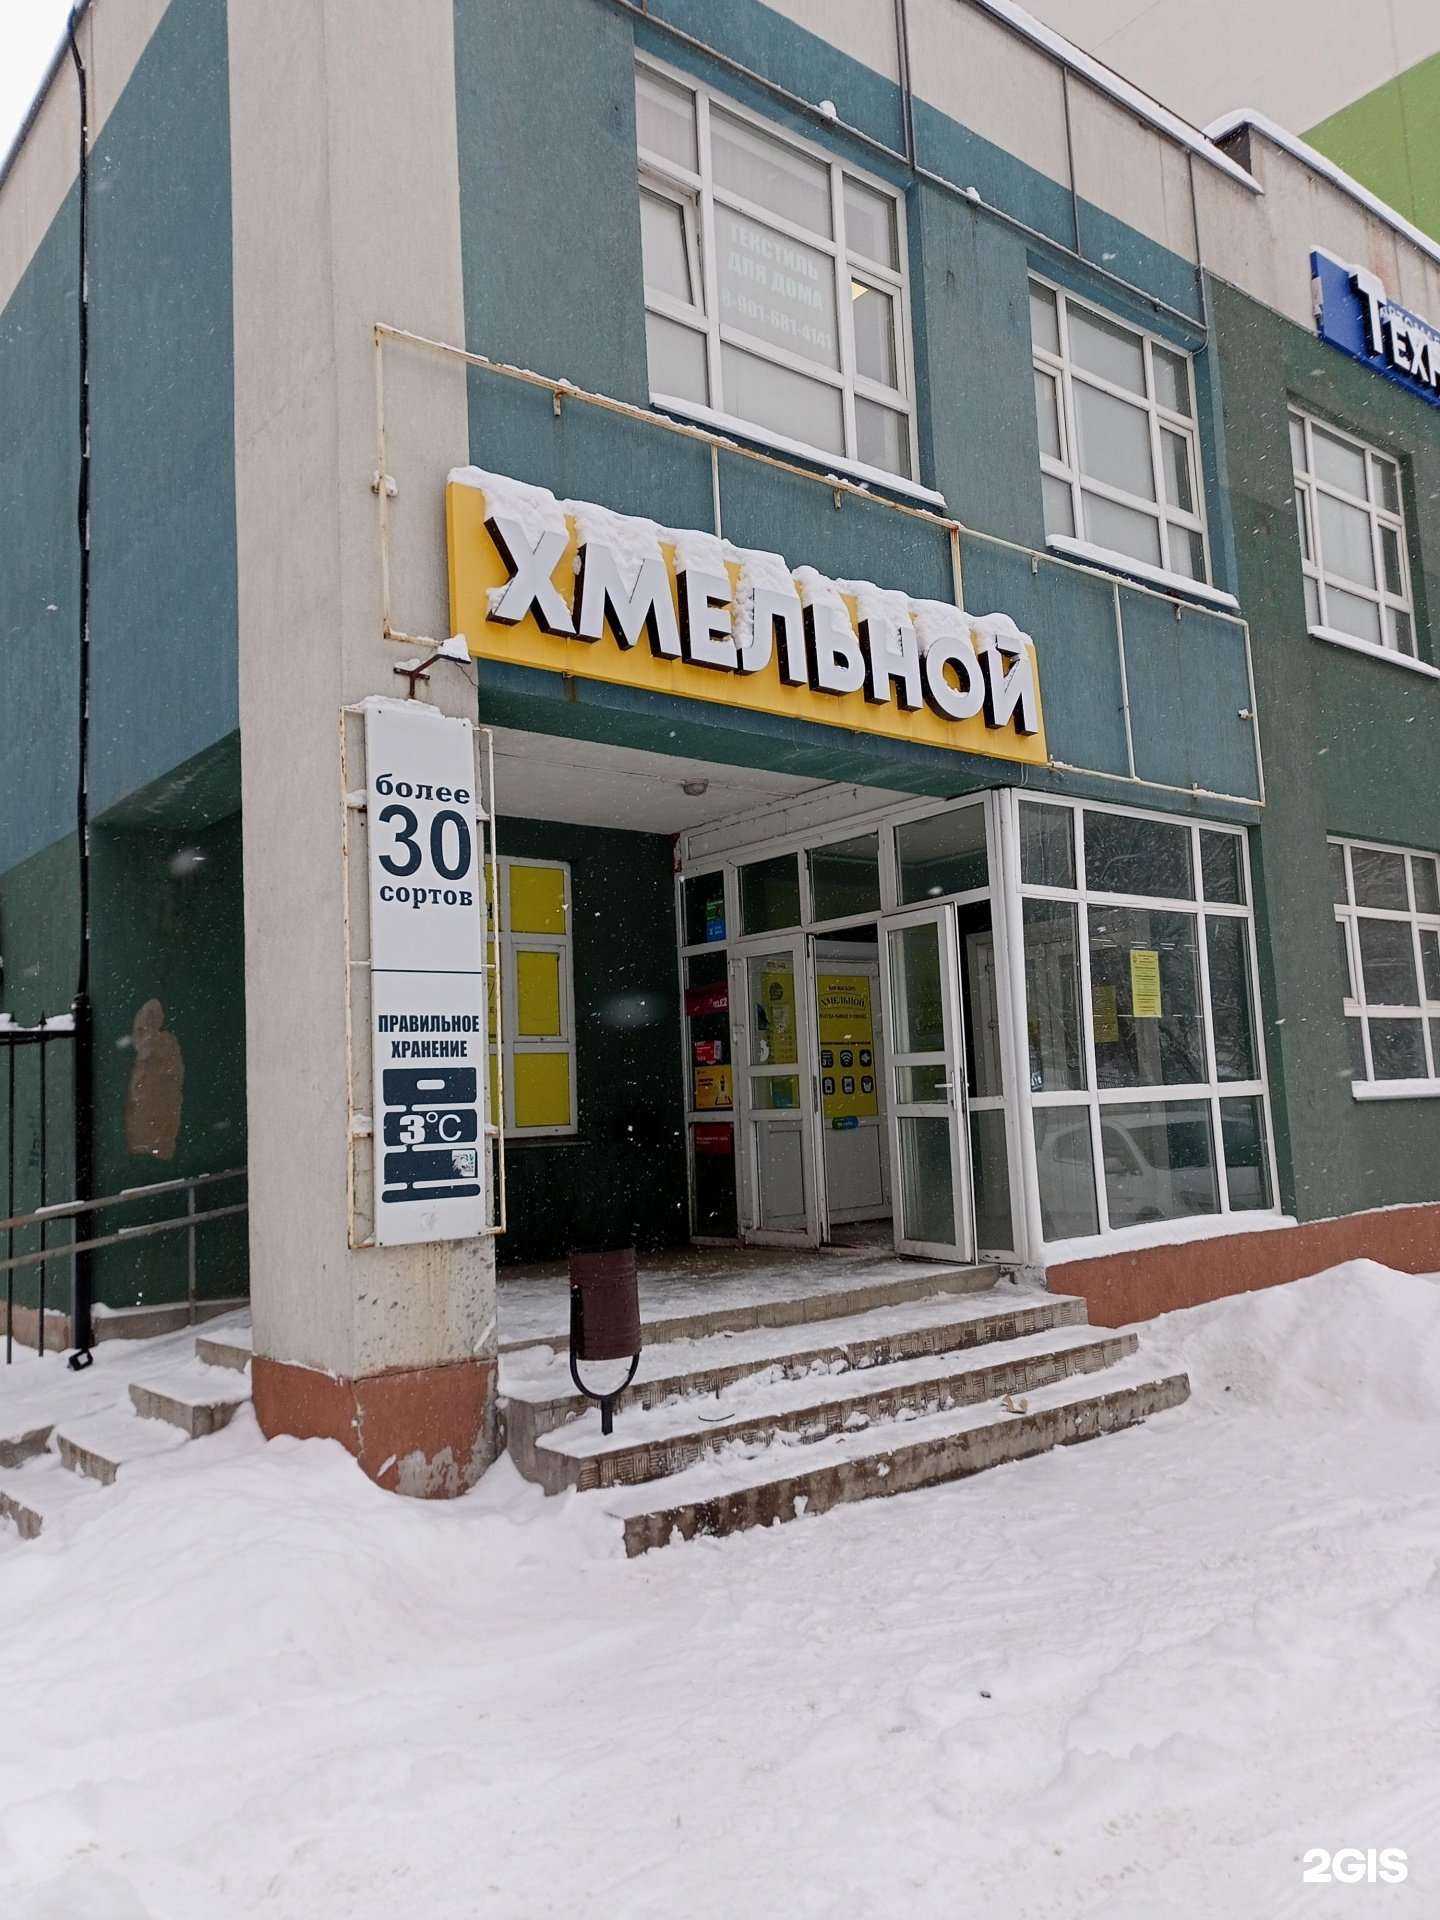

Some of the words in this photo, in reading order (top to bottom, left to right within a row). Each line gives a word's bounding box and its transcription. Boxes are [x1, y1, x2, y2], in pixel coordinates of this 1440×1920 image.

[484, 513, 1039, 737] ХМЕЛЬНОЙ
[375, 773, 471, 804] более
[378, 803, 472, 881] 30
[379, 885, 473, 909] сортов
[378, 1015, 480, 1033] ПРАВИЛЬНОЕ
[391, 1040, 468, 1058] ХРАНЕНИЕ
